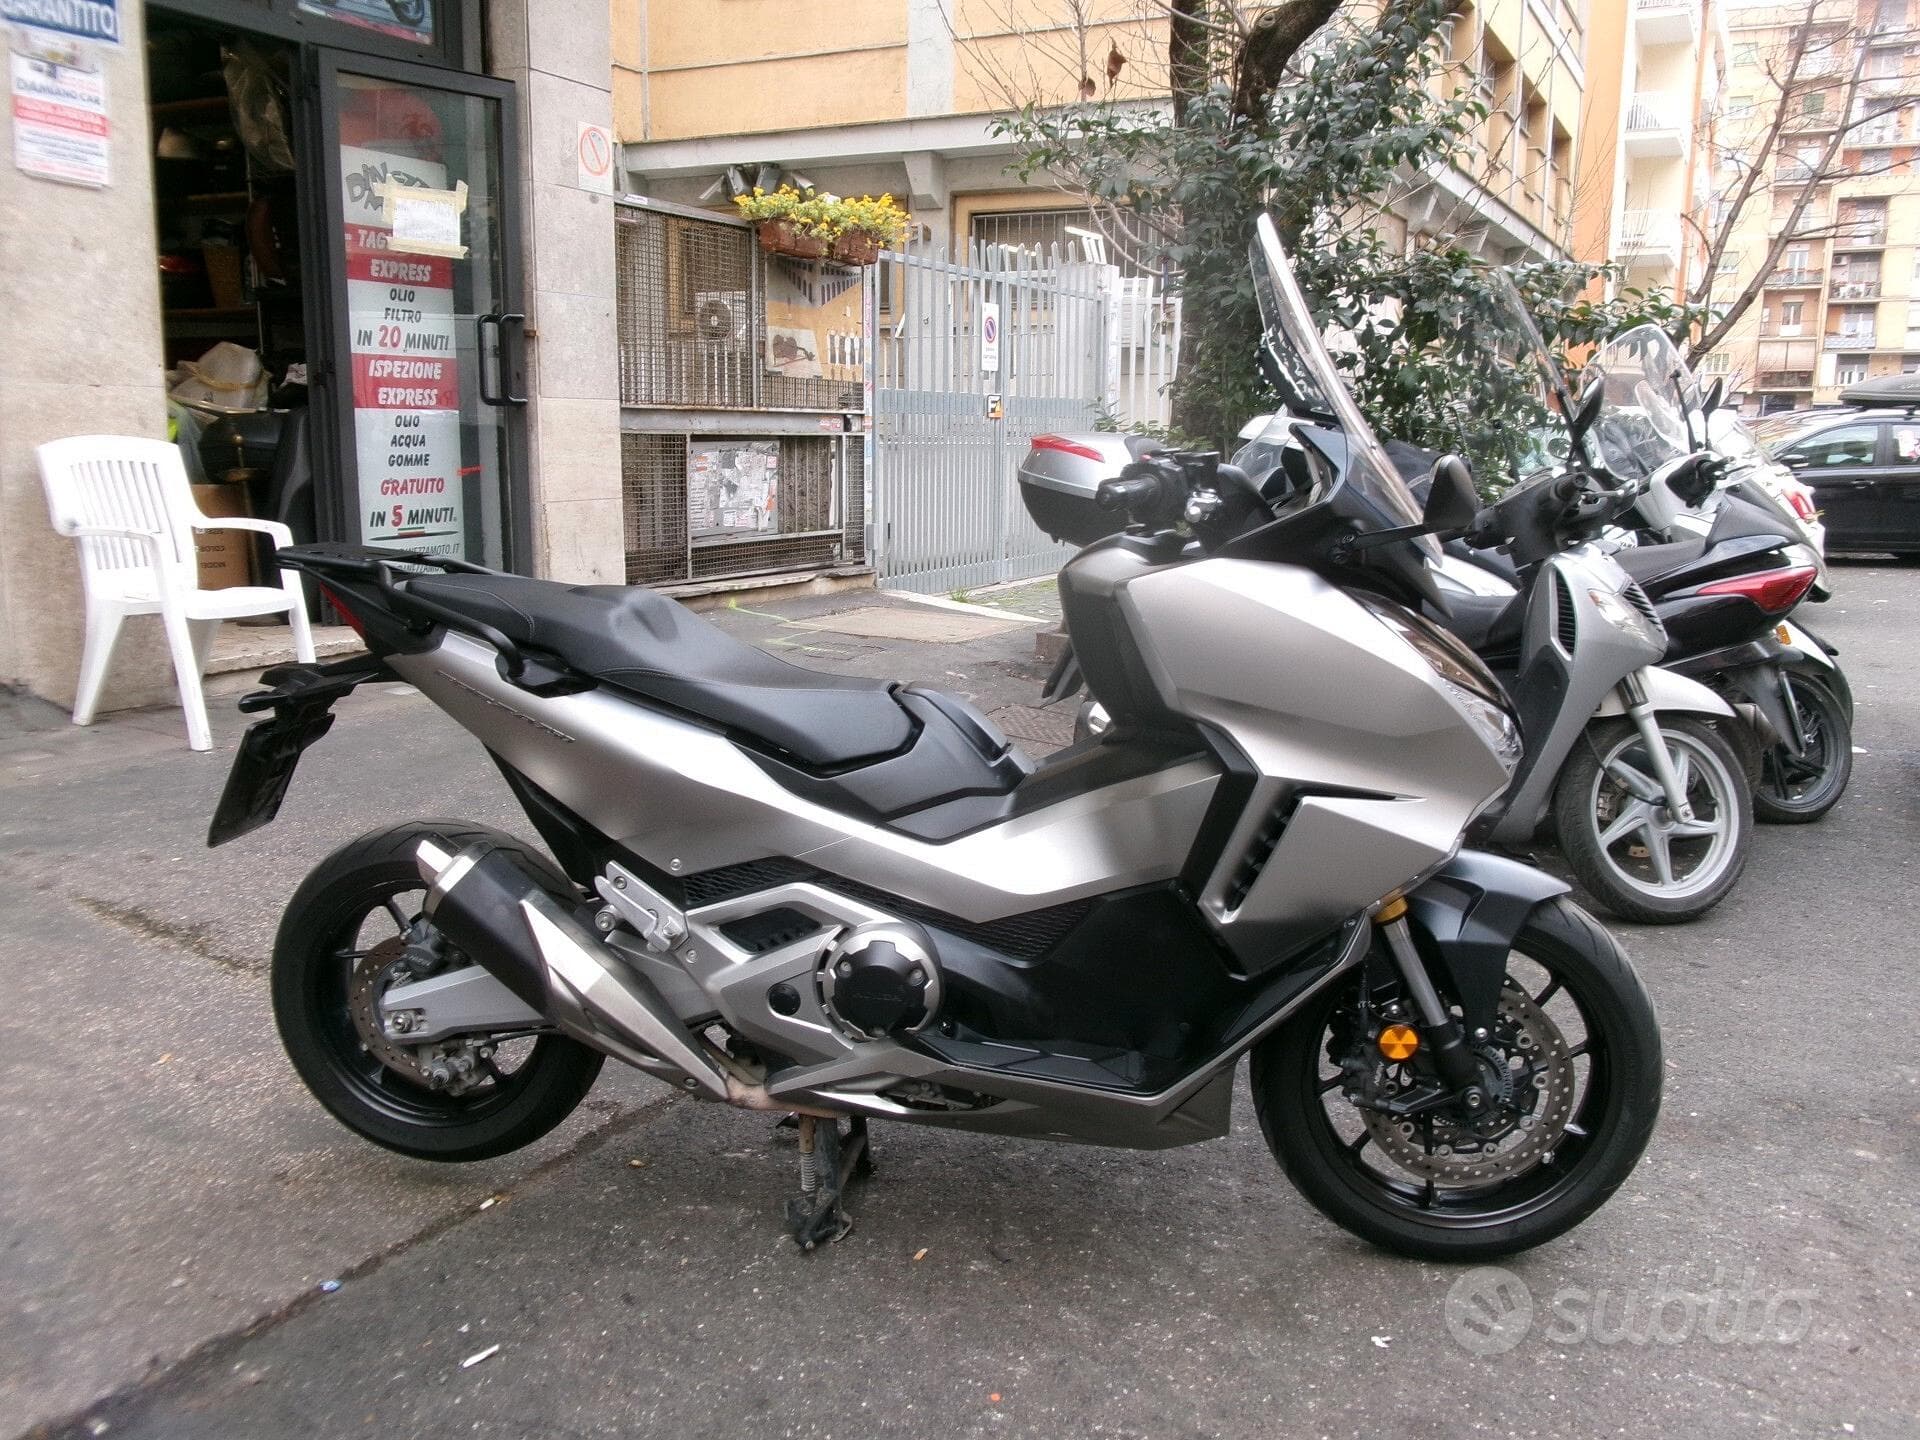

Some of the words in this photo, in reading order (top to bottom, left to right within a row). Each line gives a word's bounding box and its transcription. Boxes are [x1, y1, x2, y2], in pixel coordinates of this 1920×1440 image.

[370, 258, 432, 282] EXPRESS
[389, 288, 415, 302] OLIO
[384, 307, 422, 324] FILTRO
[357, 329, 373, 346] IN
[378, 324, 401, 349] 20
[404, 332, 450, 351] MINUTI
[368, 359, 443, 380] ISPEZIONE
[377, 386, 439, 407] EXPRESS
[395, 415, 420, 428] OLIO
[390, 434, 426, 449] ACQUA
[388, 453, 431, 467] GOMME
[380, 476, 445, 496] GRATUITO
[369, 510, 387, 528] IN
[391, 504, 403, 527] 5
